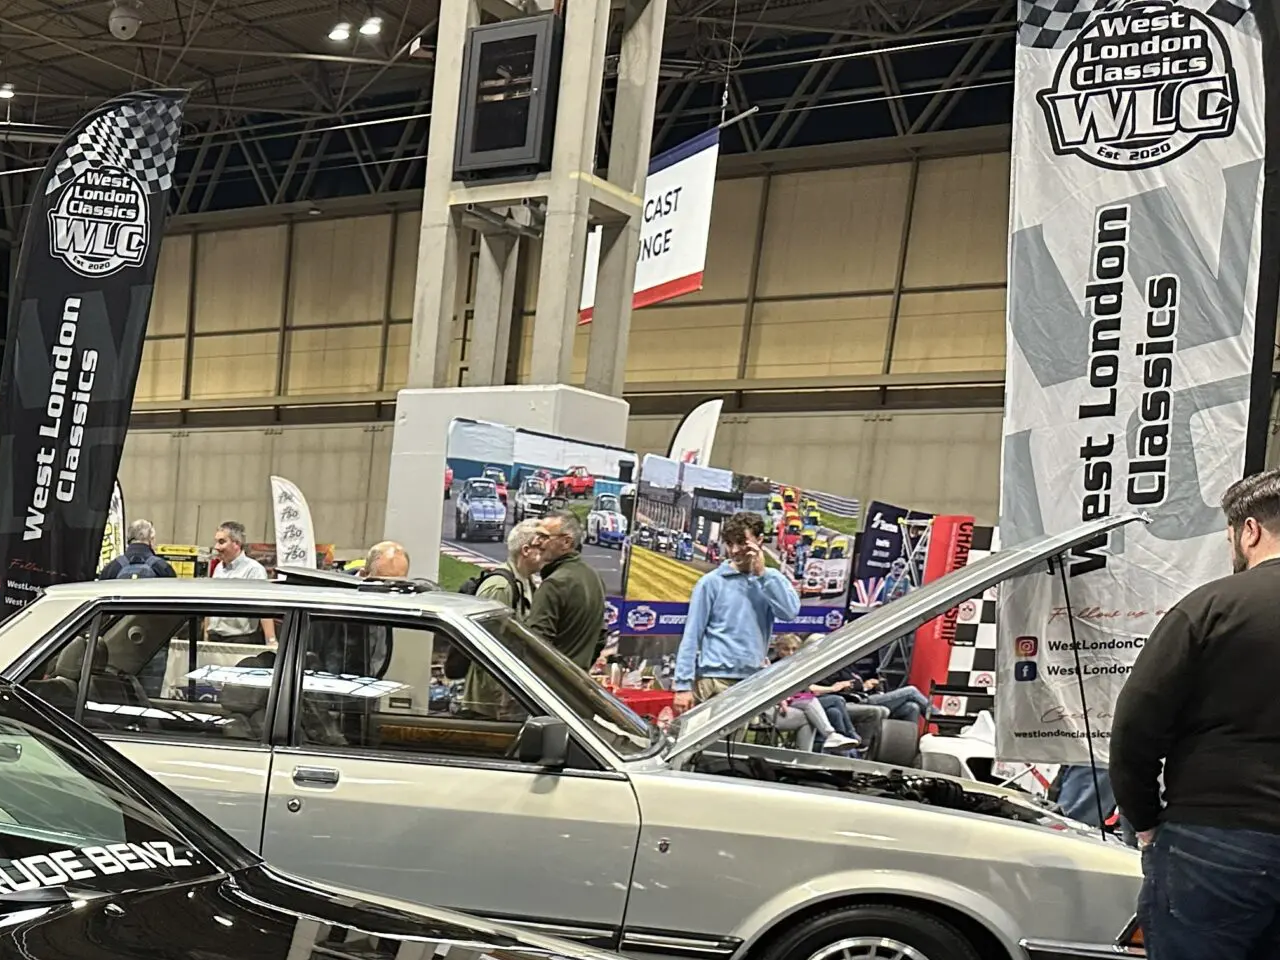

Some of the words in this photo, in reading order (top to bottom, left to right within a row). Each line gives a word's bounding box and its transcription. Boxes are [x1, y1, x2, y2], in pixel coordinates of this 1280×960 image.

[1101, 11, 1184, 37] West
[1083, 34, 1202, 63] London
[1076, 56, 1207, 86] Classics
[1052, 78, 1231, 144] WLC
[1097, 146, 1120, 160] Est
[1129, 143, 1171, 160] 2020
[74, 185, 136, 204] London
[87, 171, 130, 189] West
[69, 201, 136, 219] Classics
[644, 187, 682, 223] CAST
[55, 217, 144, 258] WLC
[73, 255, 84, 267] Est
[88, 262, 111, 270] 2020
[1078, 205, 1128, 420] London
[39, 297, 82, 438] London
[1127, 276, 1178, 505] Classics
[56, 349, 99, 502] Classics
[23, 447, 56, 541] West
[284, 550, 306, 561] 750
[1048, 606, 1120, 625] Fllow
